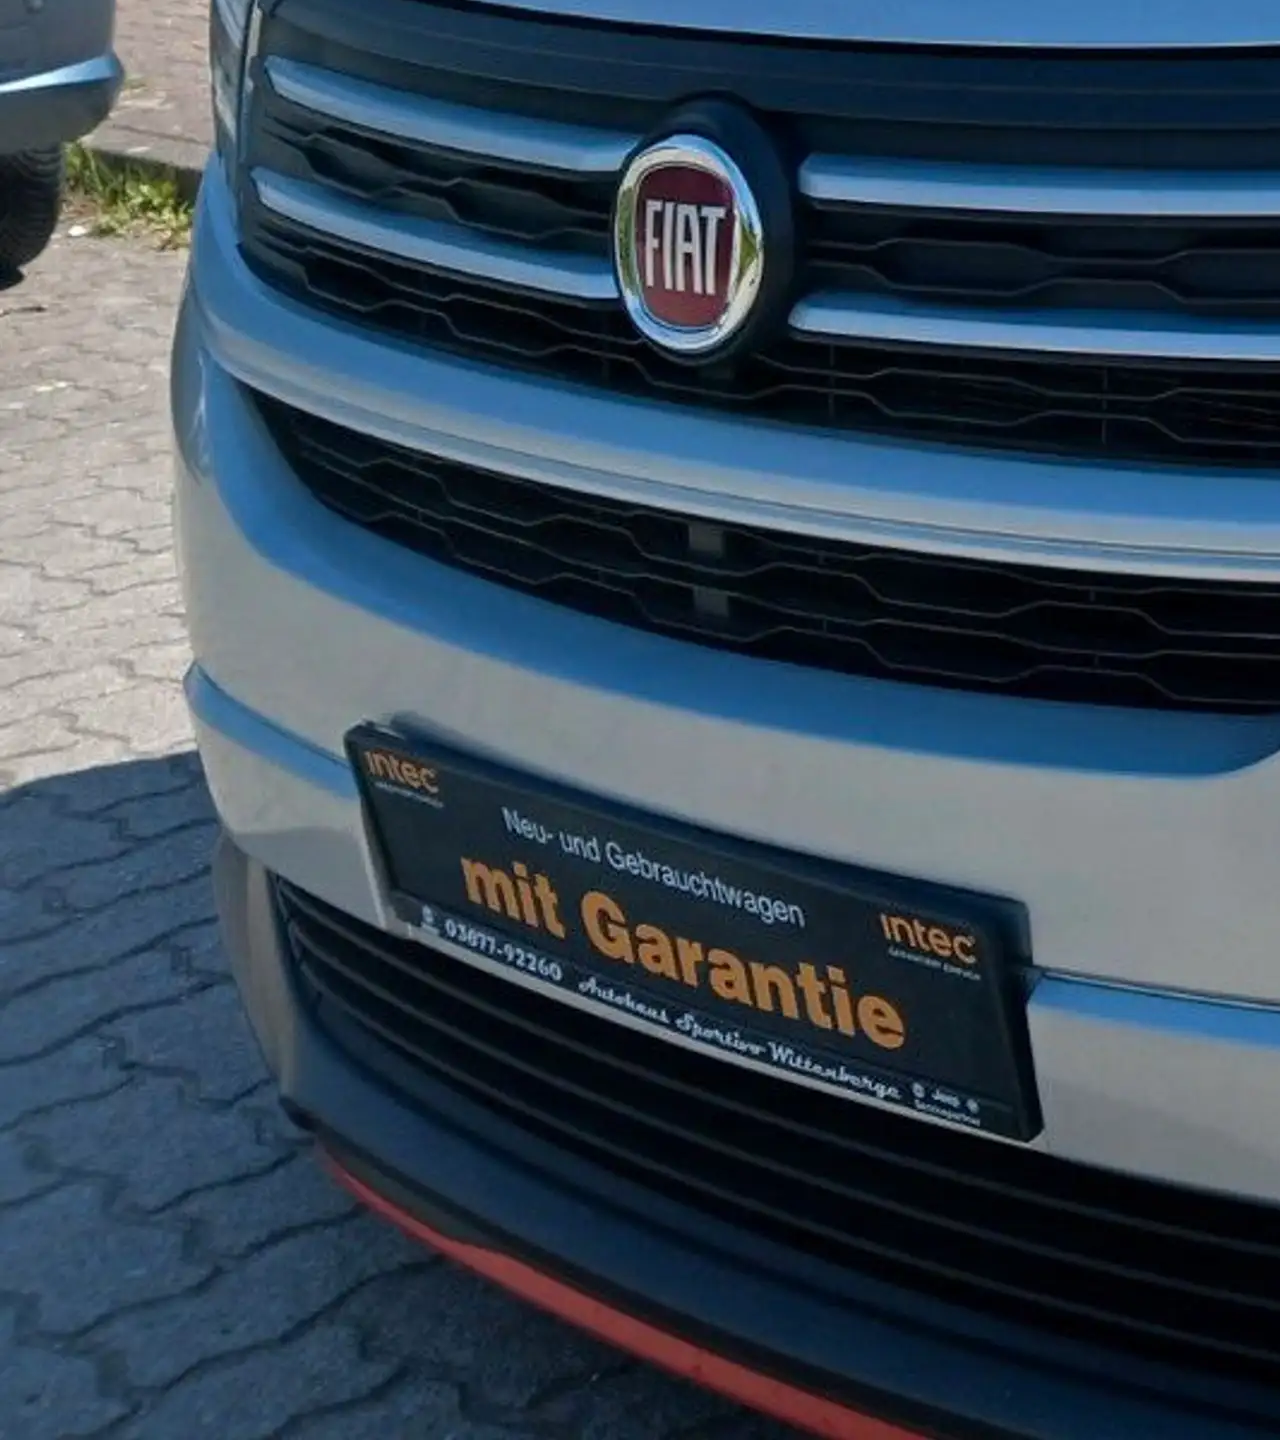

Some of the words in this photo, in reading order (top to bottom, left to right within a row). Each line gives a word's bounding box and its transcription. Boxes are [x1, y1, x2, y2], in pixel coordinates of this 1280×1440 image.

[645, 199, 727, 296] FIAT
[502, 806, 553, 845] Neu-
[559, 830, 601, 862] und
[604, 841, 806, 929] Gebrauchtwagen
[460, 856, 566, 940] mit
[580, 889, 905, 1049] Garantie
[578, 976, 670, 1024] Autohaus
